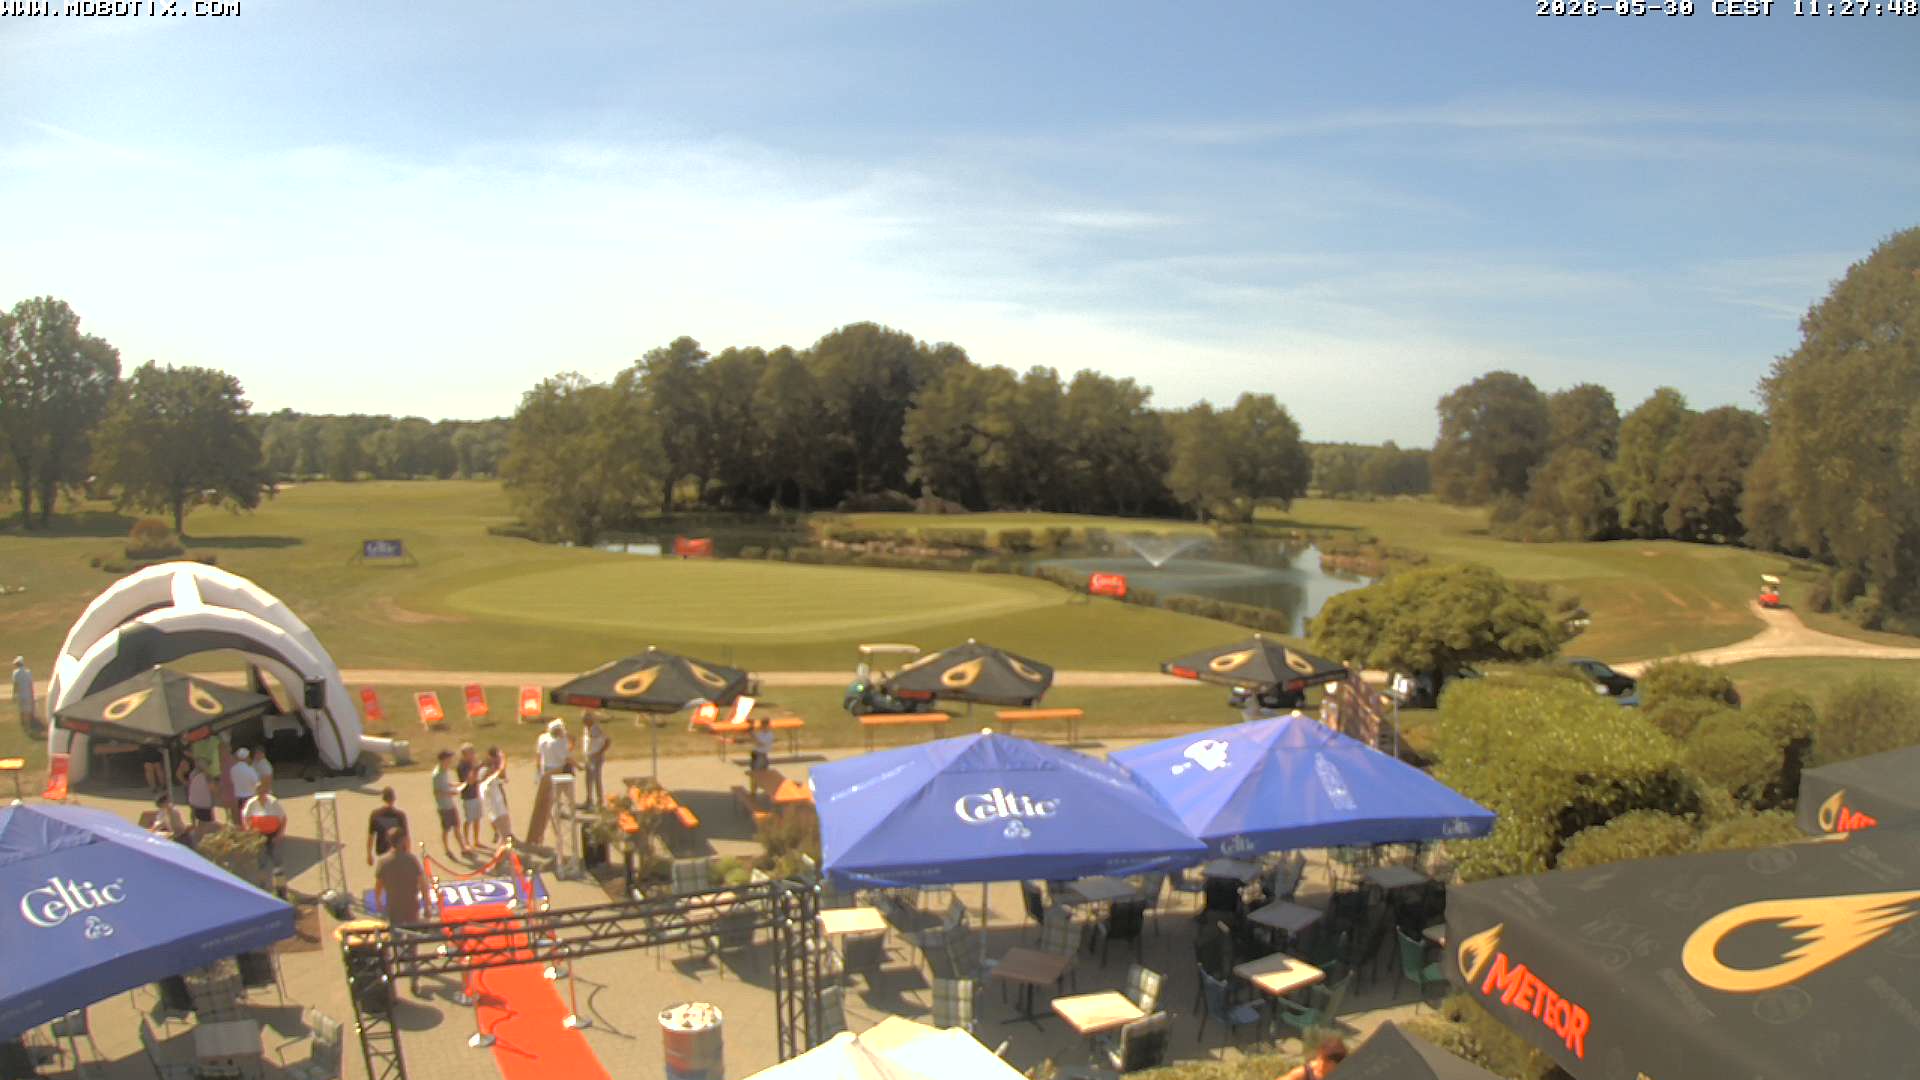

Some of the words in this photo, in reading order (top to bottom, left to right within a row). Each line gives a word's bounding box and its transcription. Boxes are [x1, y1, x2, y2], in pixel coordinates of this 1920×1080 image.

[954, 787, 1059, 824] Celtic
[19, 876, 127, 928] Celtic
[1481, 952, 1592, 1060] METEOR
